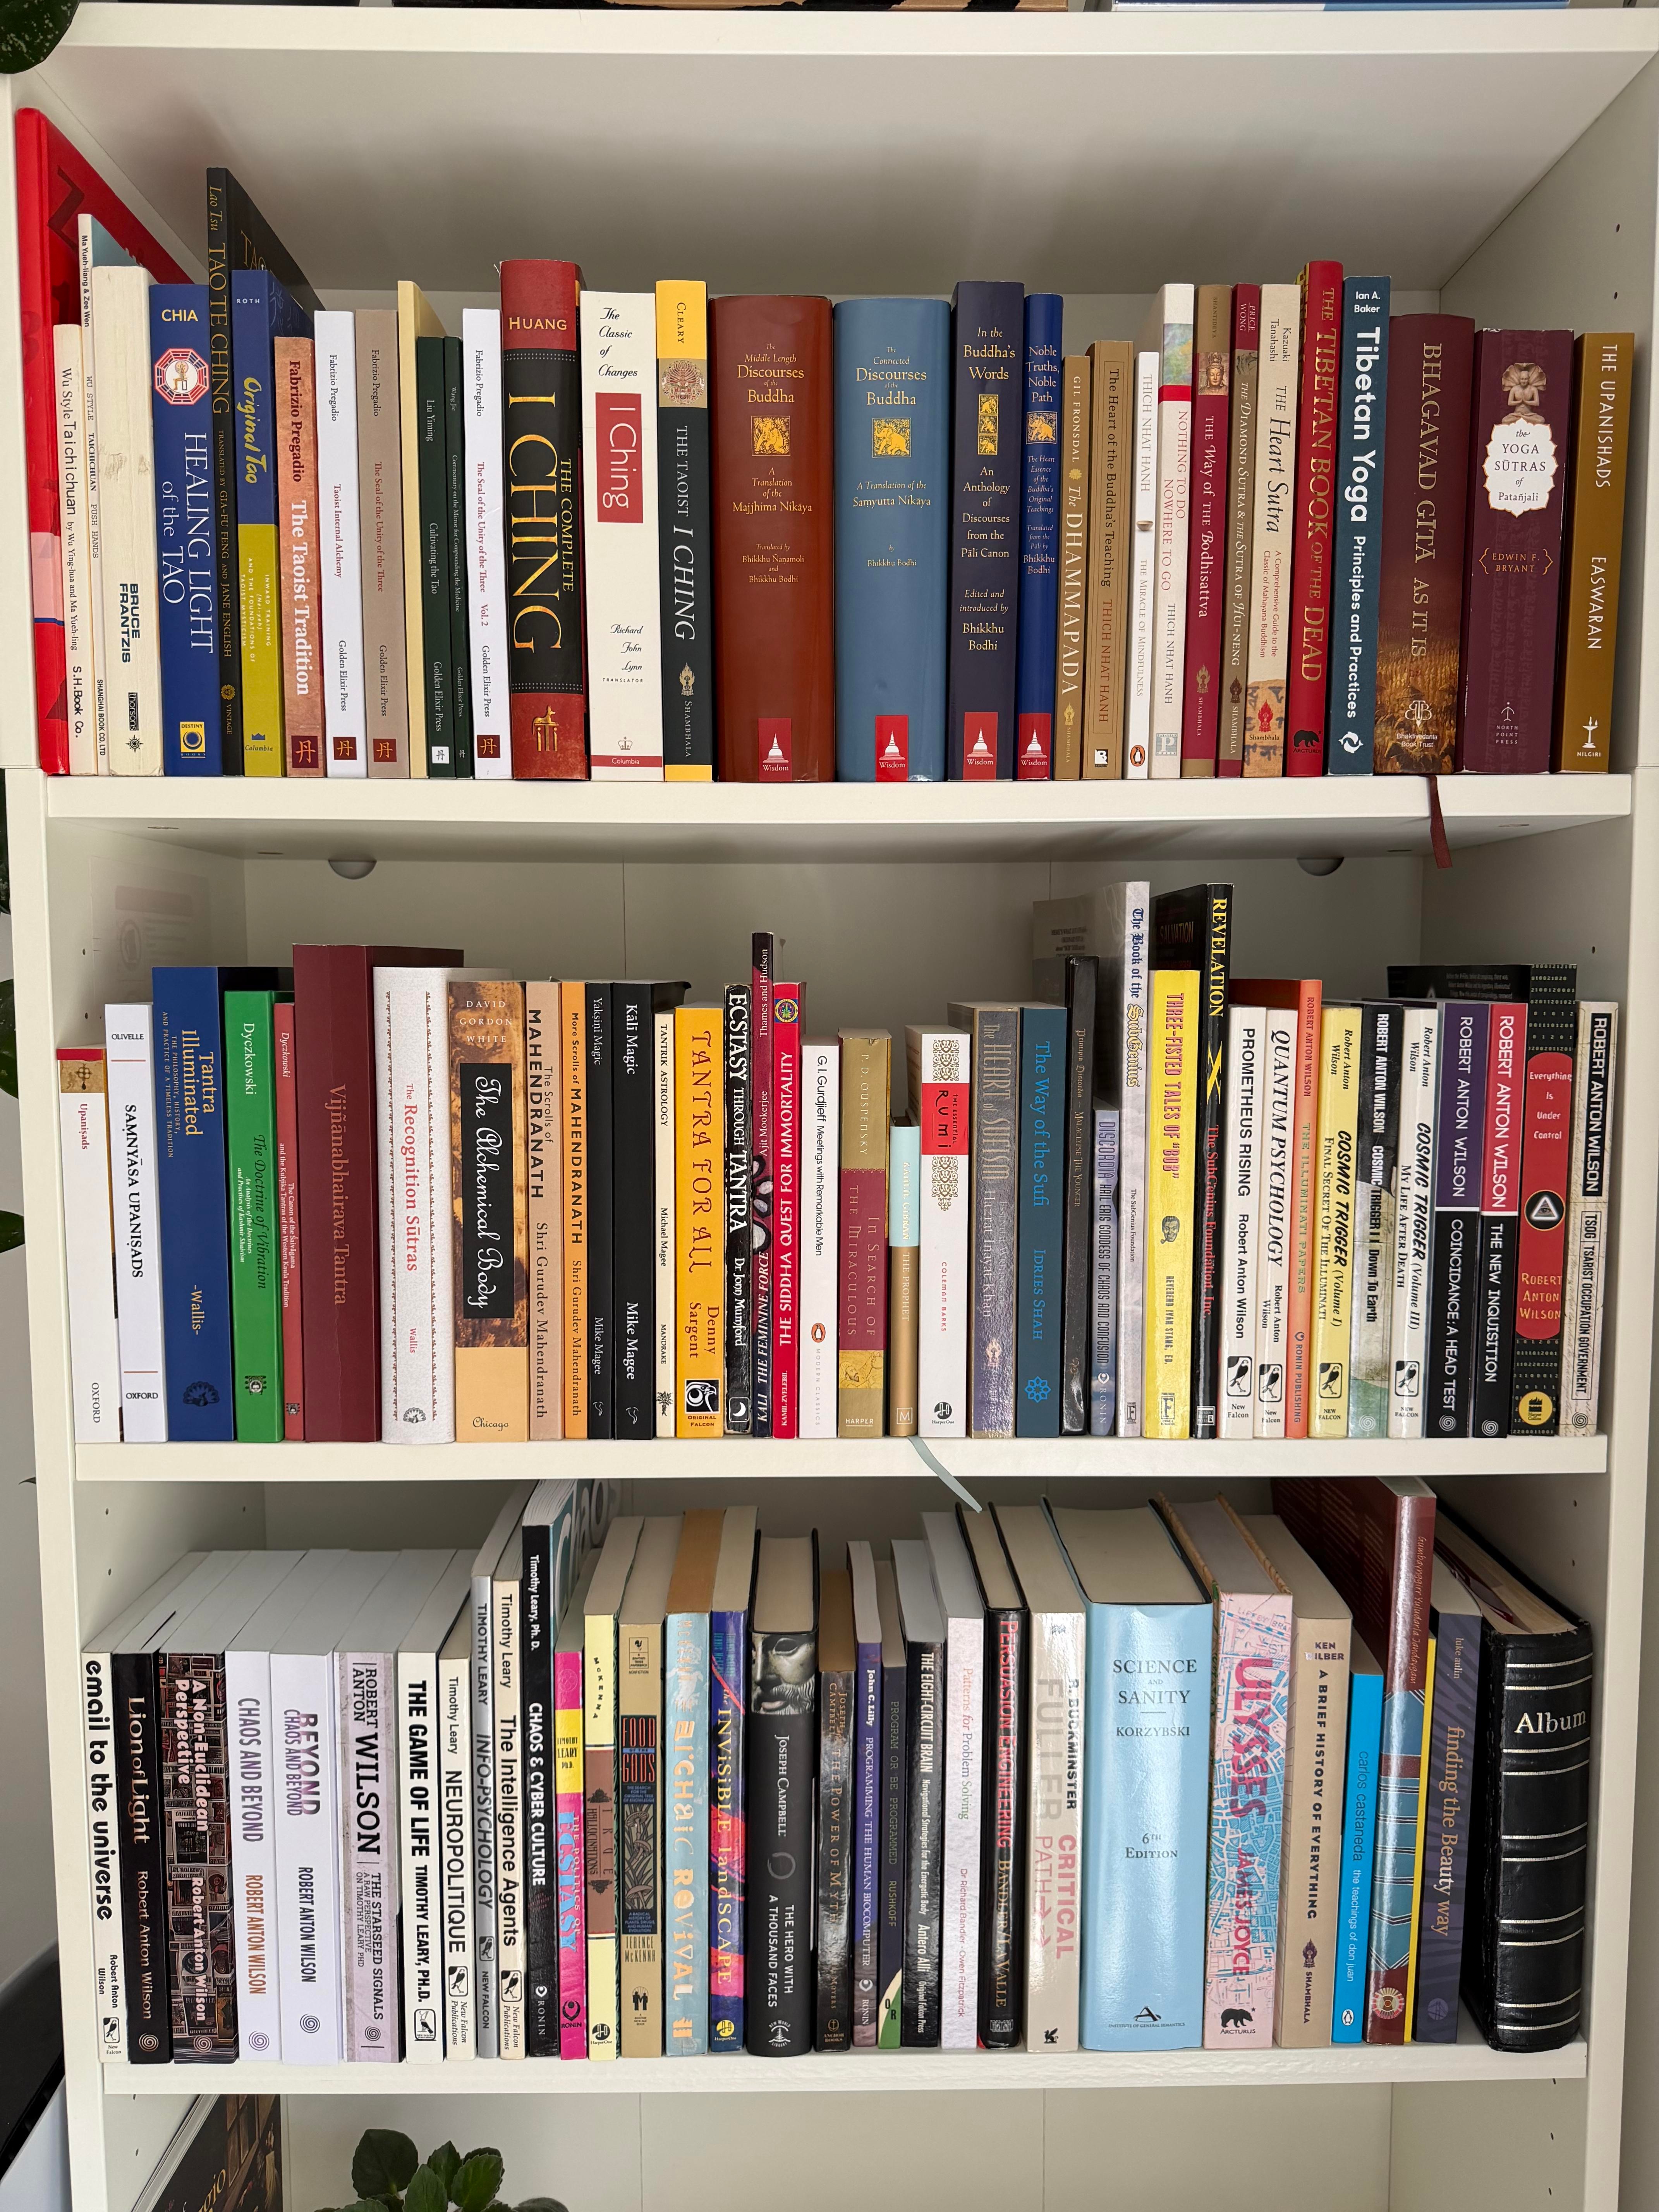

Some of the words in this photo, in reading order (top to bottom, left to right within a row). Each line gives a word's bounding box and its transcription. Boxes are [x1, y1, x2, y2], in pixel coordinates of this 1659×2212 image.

[210, 186, 222, 206] Lao
[210, 212, 222, 230] Tsu
[82, 235, 88, 246] Ma
[209, 242, 225, 291] TAO
[210, 297, 227, 326] TE
[600, 308, 620, 320] The
[1354, 305, 1380, 313] Baker
[1355, 292, 1369, 300] Ian
[1372, 292, 1380, 300] A.
[161, 309, 198, 321] CHIA
[599, 326, 632, 338] Classic
[600, 346, 610, 358] of
[211, 333, 229, 414] CHING
[290, 361, 300, 417] Fabrizio
[598, 366, 637, 379] Changes
[737, 365, 804, 379] Discourses
[969, 368, 1009, 380] Words
[1353, 327, 1380, 440] Tibetan
[748, 389, 794, 403] Buddha
[237, 378, 262, 452] Original
[289, 421, 302, 482] Pregadio
[1495, 460, 1546, 471] SŪTRAS
[1502, 444, 1540, 454] YOGA
[245, 455, 267, 484] Tao
[560, 459, 571, 492] THE
[1344, 450, 1376, 522] Yoga
[185, 433, 211, 559] HEALING
[733, 501, 776, 513] Majjhima
[1499, 492, 1539, 502] Patañjali
[292, 500, 307, 538] The
[561, 498, 574, 592] COMPLETE
[292, 542, 308, 601] Taoist
[1199, 531, 1214, 618] Bodhisattva
[130, 583, 139, 639] BRUCE
[189, 570, 213, 653] LIGHT
[1588, 557, 1606, 649] EASWARAN
[120, 583, 131, 663] FRANTZIS
[610, 624, 642, 634] Richard
[294, 605, 309, 695] Tradition
[621, 642, 642, 653] John
[1301, 606, 1324, 682] DEAD
[622, 661, 642, 672] Lynn
[760, 949, 768, 982] Hudson
[1209, 898, 1227, 1017] REVELATION
[242, 1023, 256, 1095] Dyczkowski
[281, 1032, 290, 1077] Dyczkowski
[182, 1030, 203, 1136] Illuminated
[200, 1051, 215, 1113] Tantra
[692, 1030, 711, 1148] TANTRA
[1239, 1029, 1255, 1139] PROMETHEUS
[1530, 1072, 1572, 1081] Everything
[475, 1076, 501, 1118] The
[529, 1009, 543, 1198] MAHENDRANATH
[1534, 1131, 1562, 1140] Control
[476, 1127, 502, 1240] Alchemical
[693, 1159, 712, 1215] FOR
[1238, 1144, 1250, 1197] RISING
[537, 1223, 548, 1251] Shri
[689, 1226, 712, 1273] ALL
[1491, 1224, 1503, 1249] THE
[468, 1248, 503, 1309] Body
[537, 1256, 548, 1315] Gurudev
[1489, 1254, 1502, 1285] NEW
[1522, 1274, 1562, 1285] ROBERT
[1520, 1308, 1561, 1319] WILSON
[1523, 1290, 1559, 1302] ANTON
[627, 1302, 639, 1335] Mike
[685, 1302, 701, 1358] Sargent
[705, 1305, 720, 1355] Denny
[1485, 1289, 1501, 1382] INQUISITION
[537, 1319, 548, 1419] Mahendranath
[623, 1338, 635, 1379] Magee
[91, 1383, 101, 1423] OXFORD
[473, 1417, 508, 1431] Chicago
[1113, 1660, 1197, 1674] SCIENCE
[86, 1661, 110, 1731] email
[408, 1680, 426, 1717] THE
[1118, 1690, 1190, 1704] SANITY
[500, 1715, 516, 1752] The
[623, 1717, 655, 1747] FOOD
[1116, 1726, 1190, 1736] KORZYBSKI
[1515, 1710, 1587, 1733] Album
[88, 1739, 109, 1764] to
[409, 1724, 428, 1780] GAME
[623, 1753, 655, 1782] GODS
[89, 1773, 113, 1812] the
[410, 1786, 429, 1811] OF
[498, 1759, 516, 1872] Intelligence
[411, 1816, 430, 1857] LIFE
[93, 1821, 117, 1920] universe
[446, 1771, 465, 1953] NEUROPOLITIQUE
[1353, 1870, 1362, 1884] the
[1434, 1834, 1458, 1896] Beauty
[245, 1874, 263, 1914] ROBERT
[416, 1865, 428, 1923] TIMOTHY
[769, 1895, 778, 1903] A
[888, 1881, 896, 1927] RUSHKOFF
[1349, 1887, 1360, 1929] teachings
[500, 1881, 519, 1947] Agents
[785, 1905, 794, 1923] THE
[1431, 1900, 1450, 1936] way
[247, 1917, 265, 1949] ANTON
[415, 1926, 429, 1966] LEARY,
[769, 1907, 778, 1972] THOUSAND
[784, 1926, 793, 1959] HERO
[1350, 1932, 1357, 1943] of
[1348, 1944, 1357, 1960] don
[248, 1952, 266, 1994] WILSON
[419, 1970, 430, 2002] PH.D.
[768, 1975, 777, 2007] FACES
[784, 1962, 793, 1994] WITH
[1346, 1963, 1355, 1982] juan
